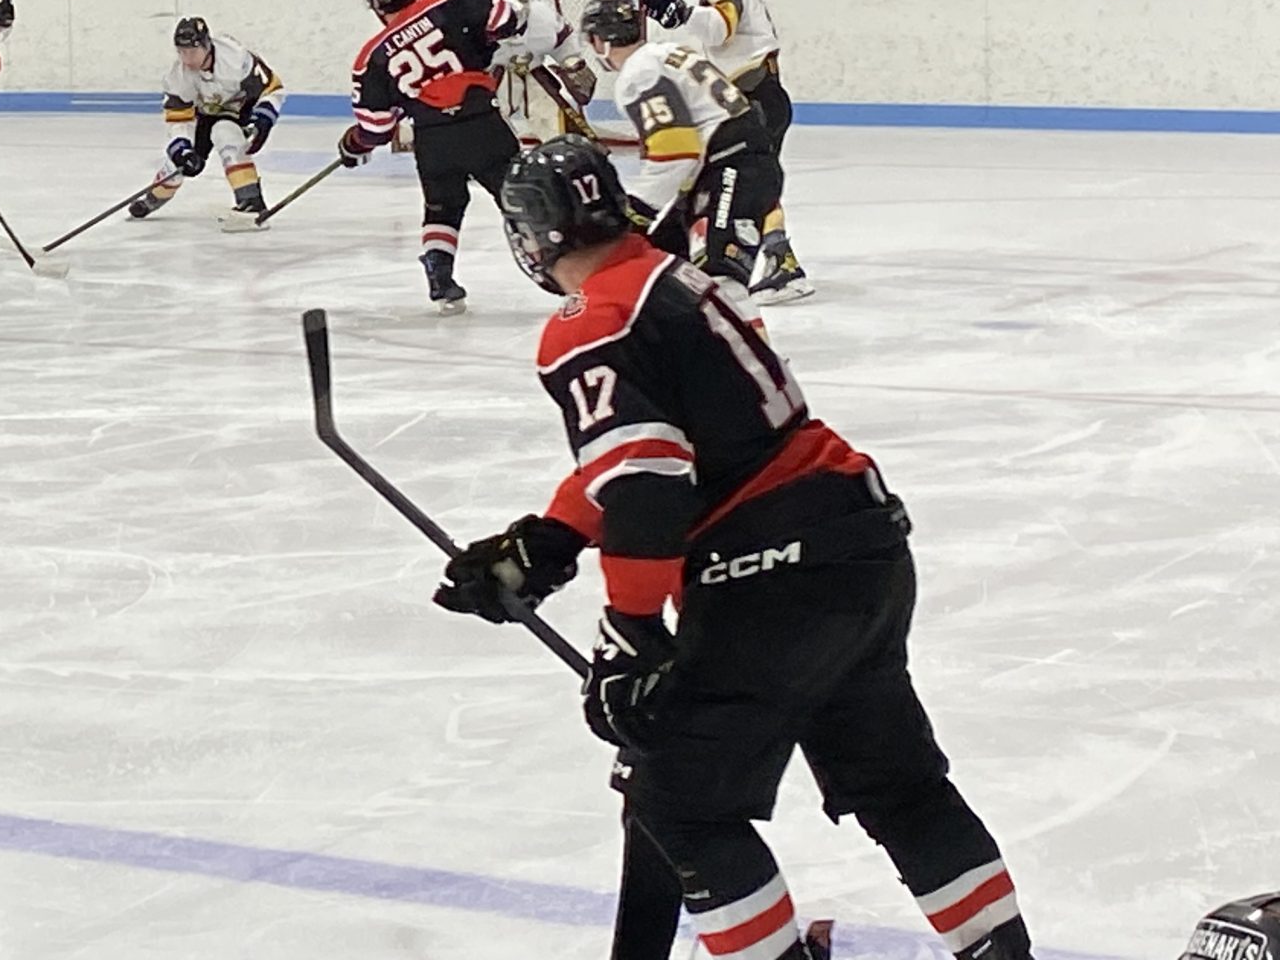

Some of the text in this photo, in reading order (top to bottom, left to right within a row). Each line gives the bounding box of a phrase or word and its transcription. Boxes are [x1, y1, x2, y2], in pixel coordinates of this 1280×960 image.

[388, 28, 463, 98] 25
[572, 174, 601, 204] 17
[569, 365, 618, 432] 17
[700, 540, 802, 585] CCM
